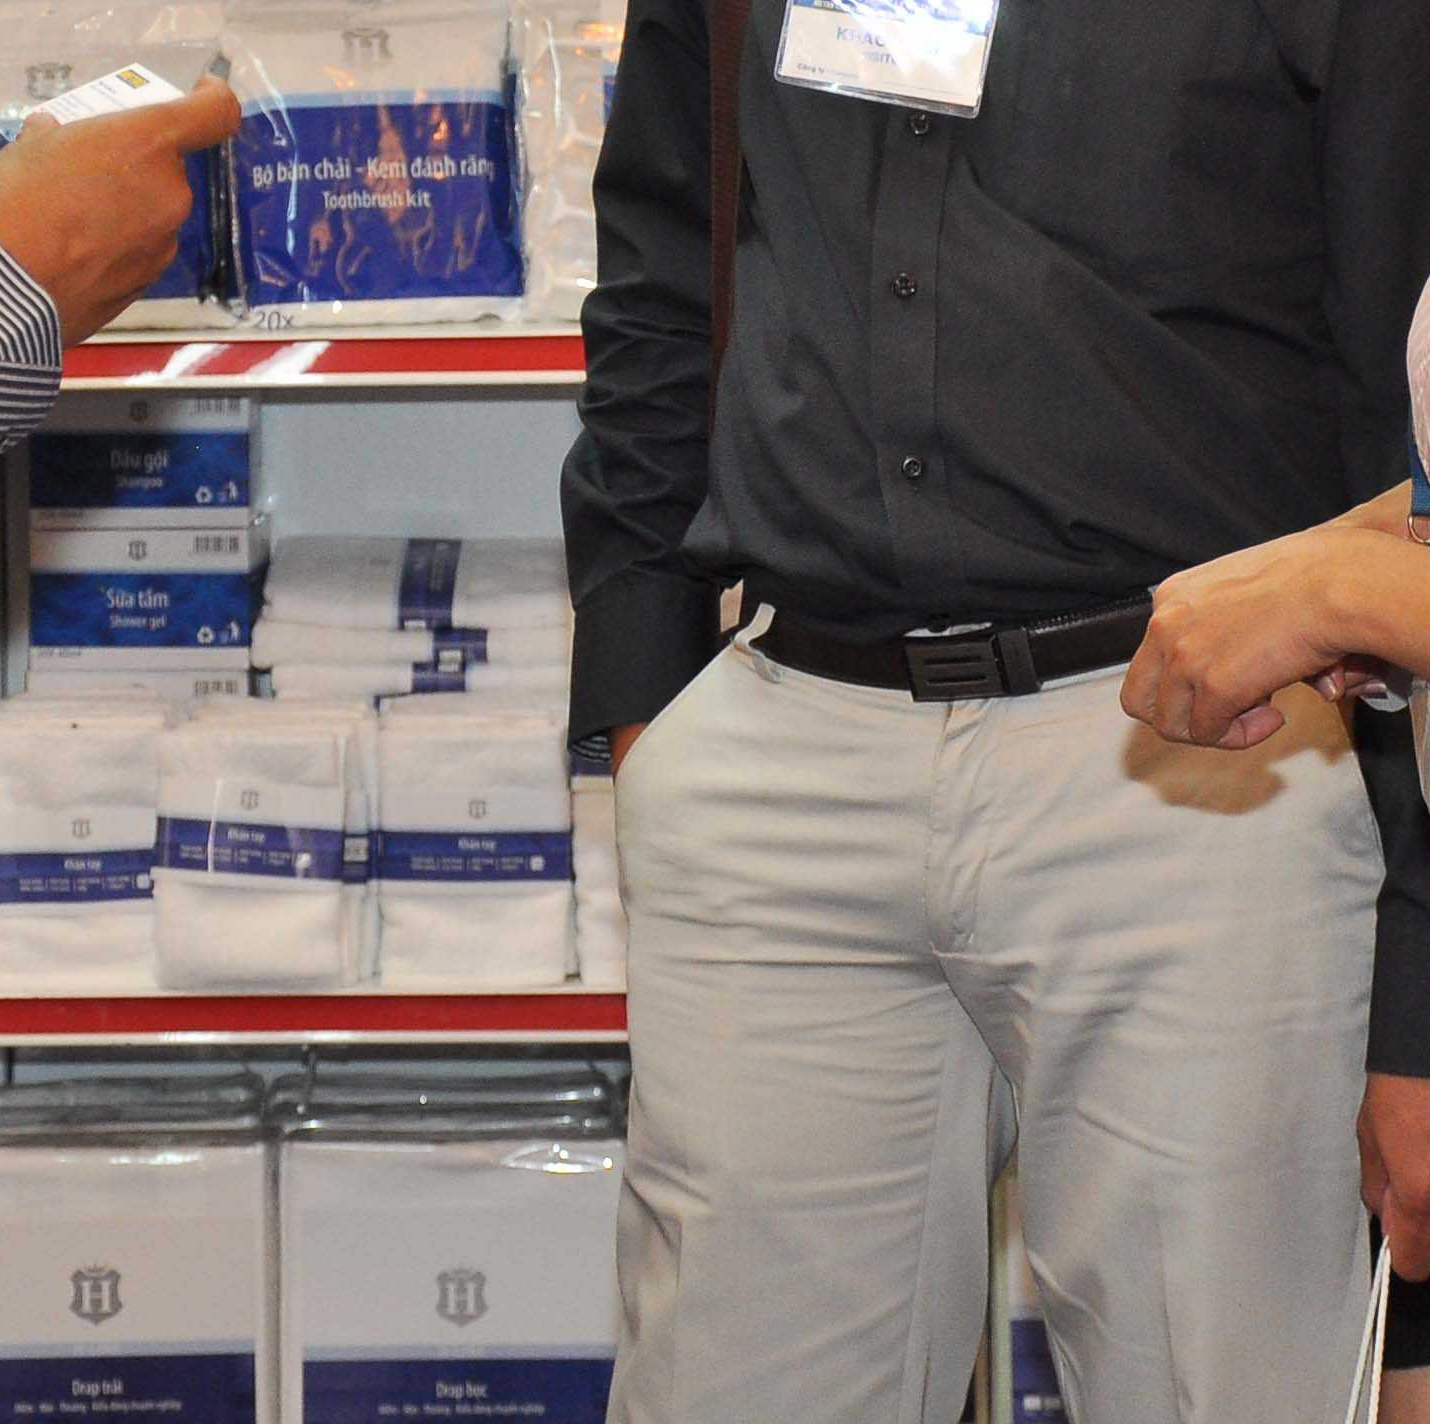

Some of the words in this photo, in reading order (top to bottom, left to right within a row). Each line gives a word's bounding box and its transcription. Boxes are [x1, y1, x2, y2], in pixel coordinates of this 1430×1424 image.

[366, 157, 407, 177] Kem
[322, 189, 404, 210] Toothbrush
[406, 188, 432, 208] kit
